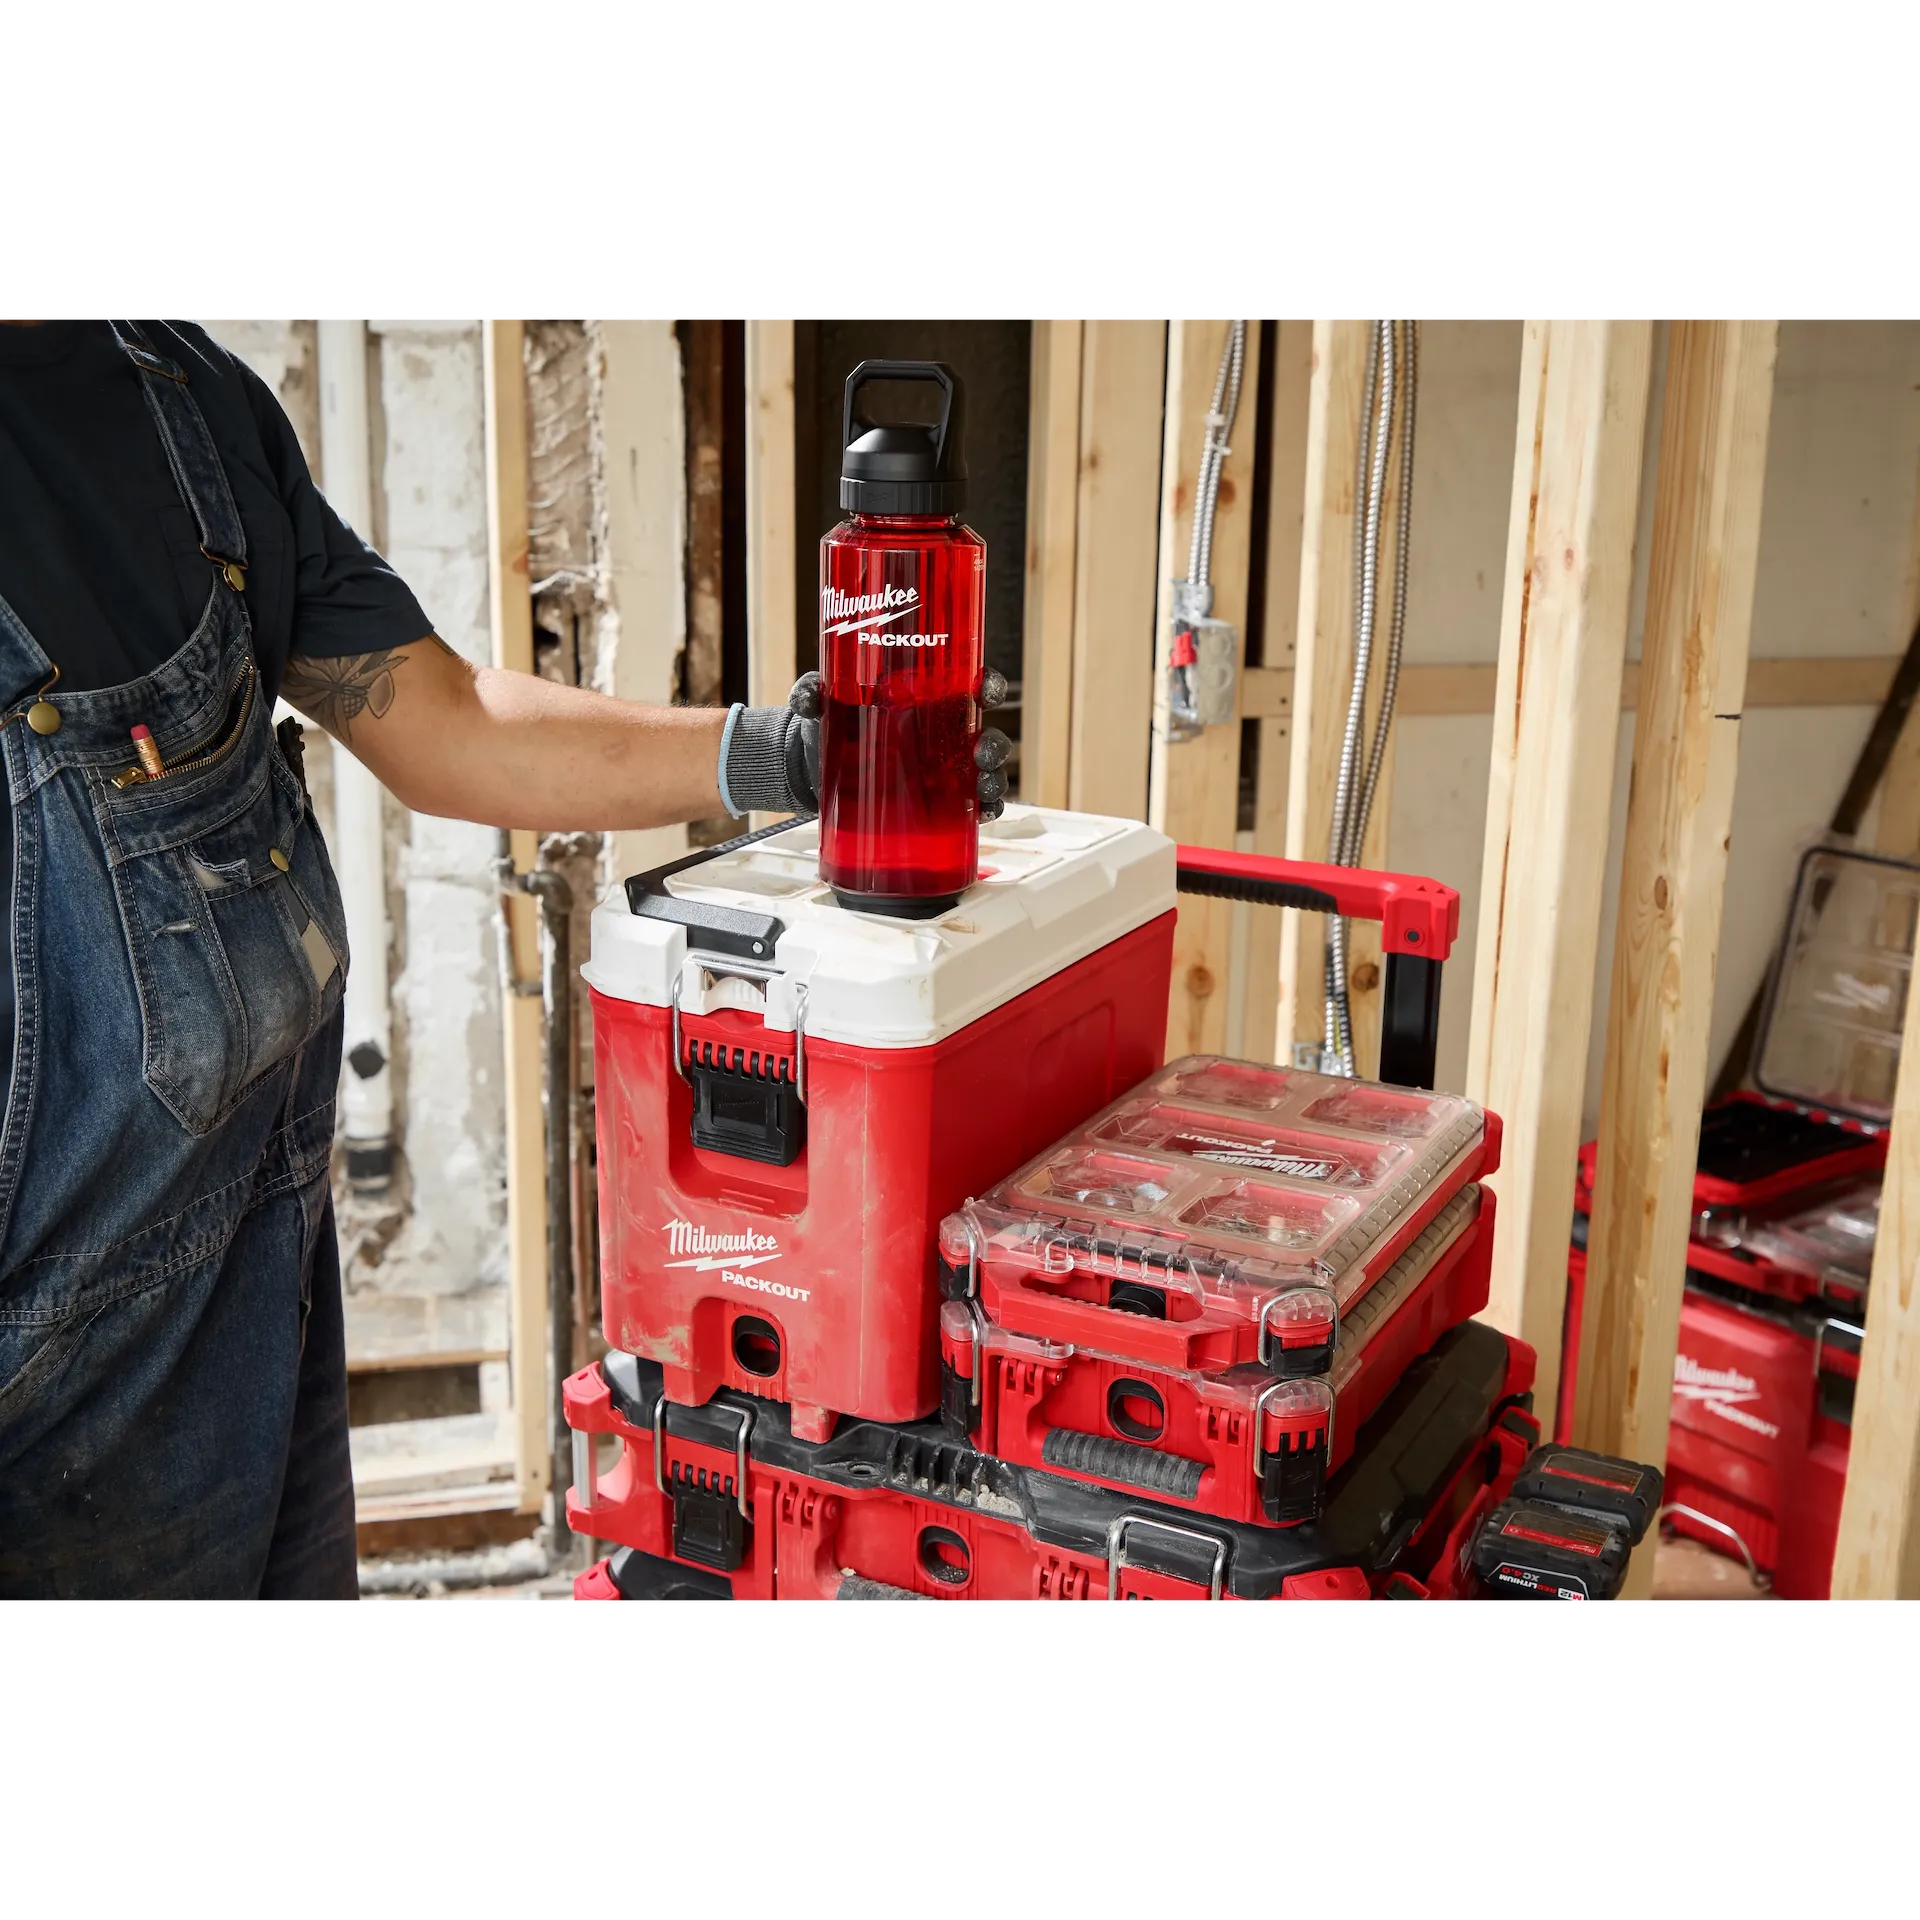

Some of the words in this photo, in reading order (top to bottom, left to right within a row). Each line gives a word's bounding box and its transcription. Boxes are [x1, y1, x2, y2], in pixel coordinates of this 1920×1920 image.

[822, 583, 919, 622] Milwaukee
[858, 632, 949, 647] PACKOUT
[1175, 1132, 1274, 1154] PACKOUT
[661, 1217, 779, 1256] Milwaukee
[721, 1269, 811, 1302] PACKOUT
[1559, 1590, 1583, 1604] M12
